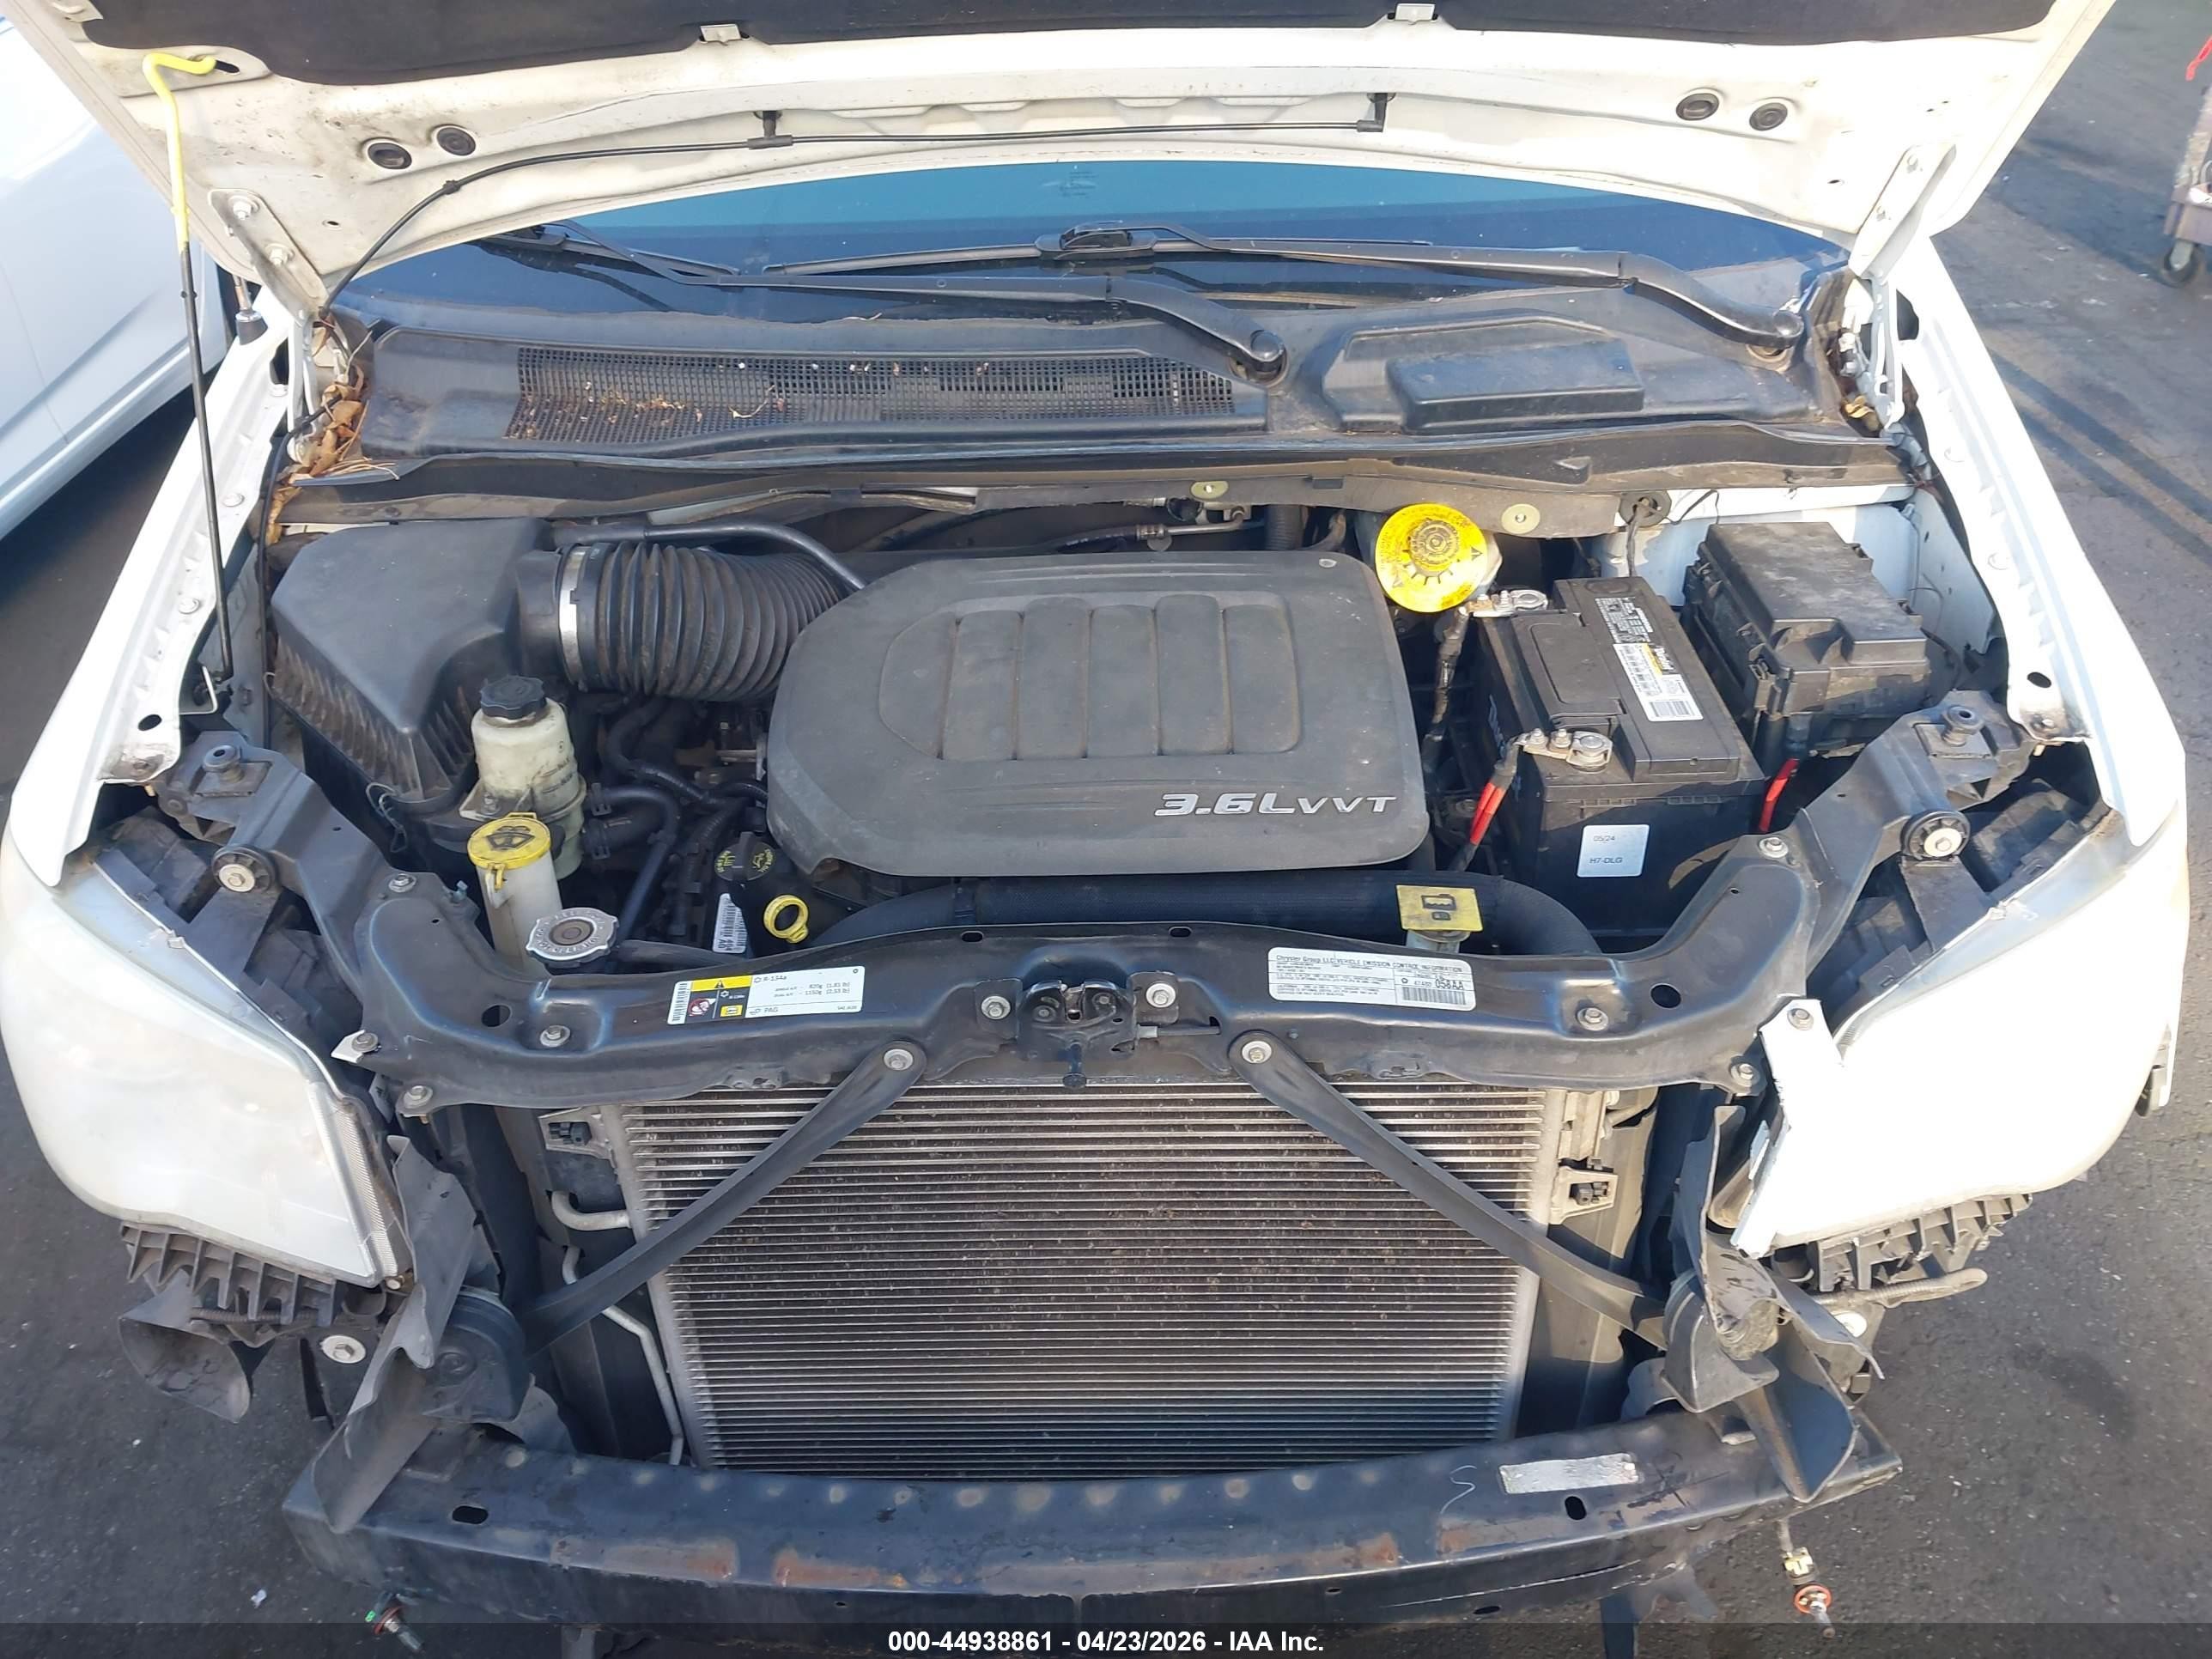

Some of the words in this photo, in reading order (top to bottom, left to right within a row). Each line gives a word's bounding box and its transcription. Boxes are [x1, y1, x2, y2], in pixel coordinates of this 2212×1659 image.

[1154, 792, 1296, 816] 3.6L
[1297, 796, 1397, 814] VVT
[1276, 954, 1301, 963] Chrysler
[1336, 957, 1361, 966] VEHICLE
[1420, 964, 1462, 973] INFORMATION
